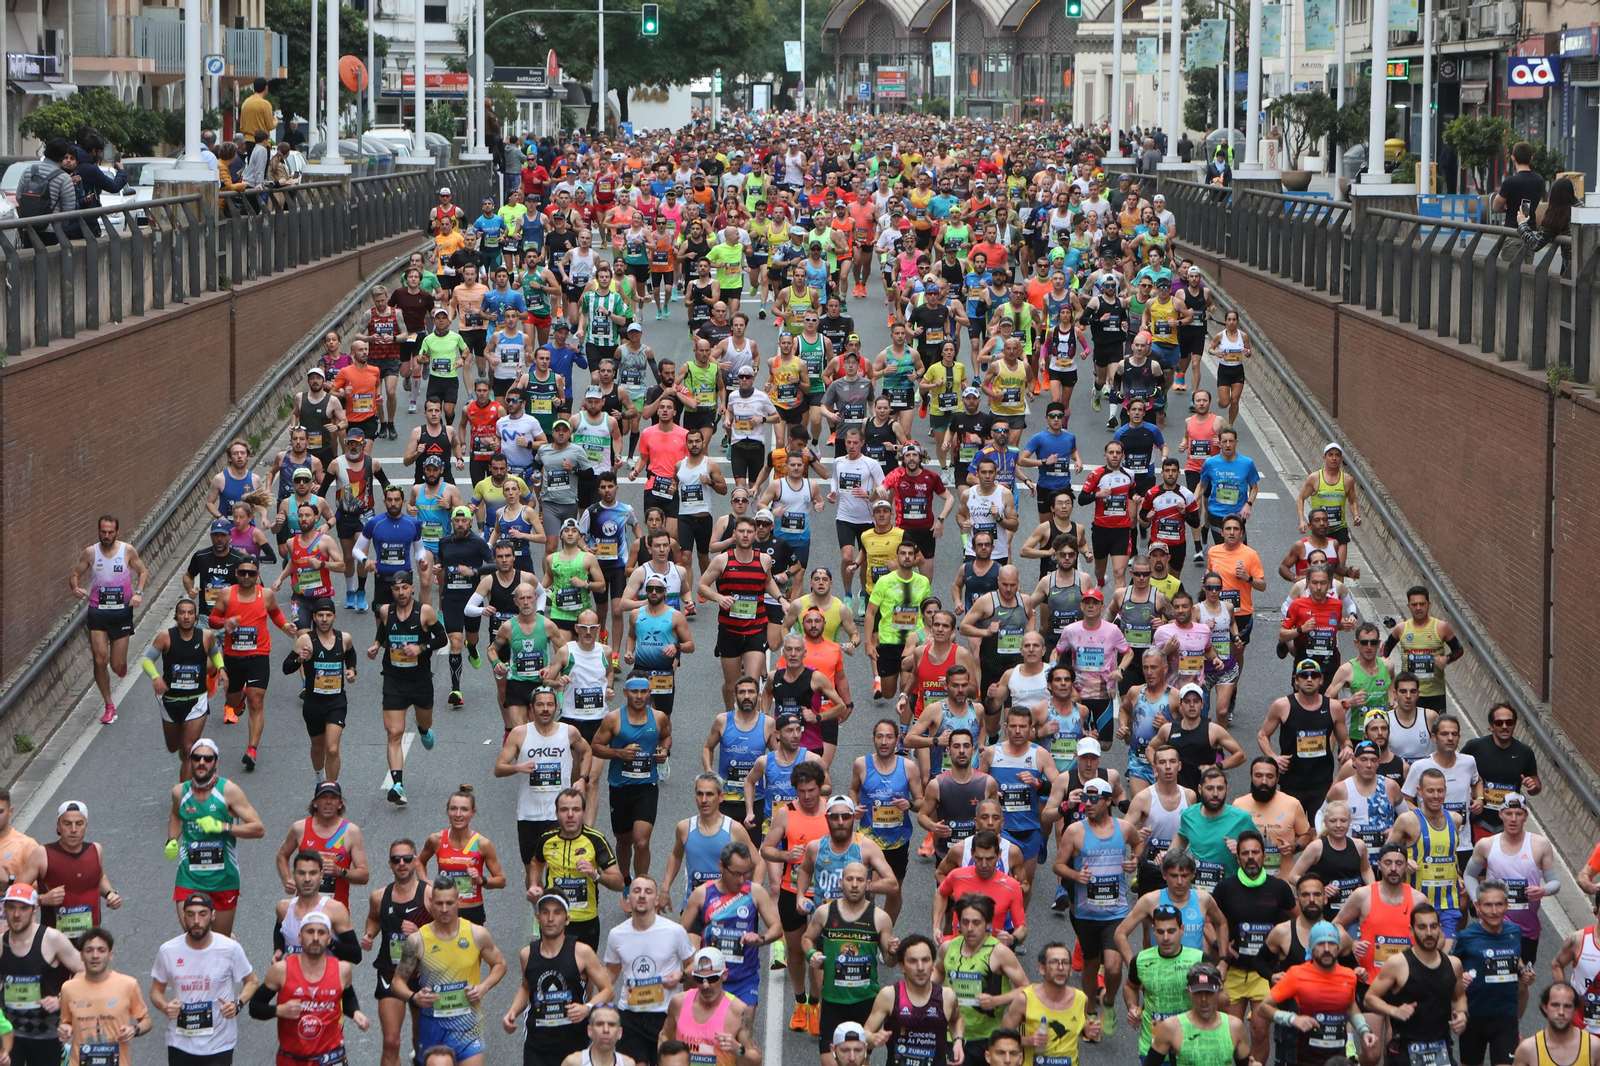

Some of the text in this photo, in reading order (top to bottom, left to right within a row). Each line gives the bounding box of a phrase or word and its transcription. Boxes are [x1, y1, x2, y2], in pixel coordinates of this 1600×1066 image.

[860, 84, 867, 93] P
[208, 566, 229, 576] PERÚ
[527, 747, 565, 758] OAKLEY
